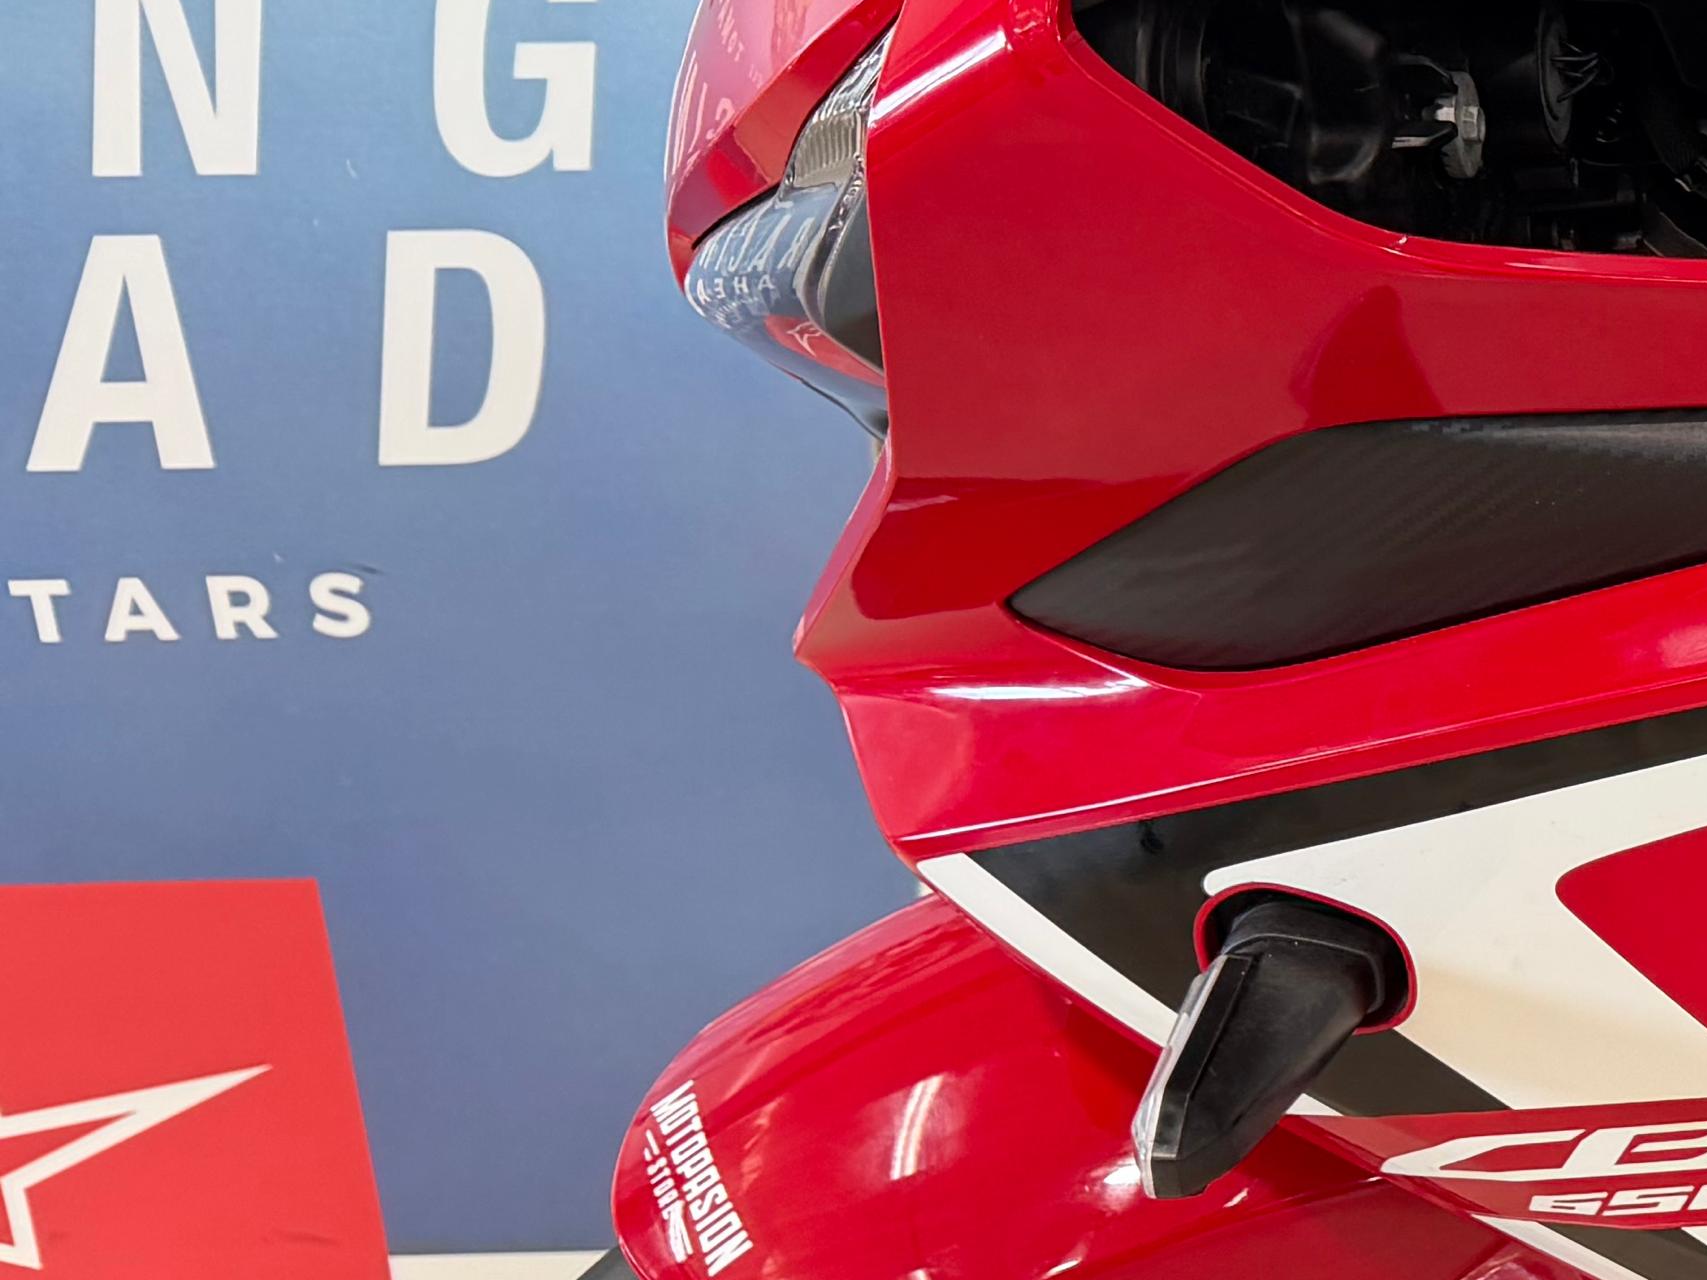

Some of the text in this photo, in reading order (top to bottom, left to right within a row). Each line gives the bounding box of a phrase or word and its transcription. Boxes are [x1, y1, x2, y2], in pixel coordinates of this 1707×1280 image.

[26, 228, 547, 473] AD
[7, 572, 372, 643] TARS
[647, 1157, 687, 1220] STORE
[651, 1080, 753, 1277] MOTOPASION
